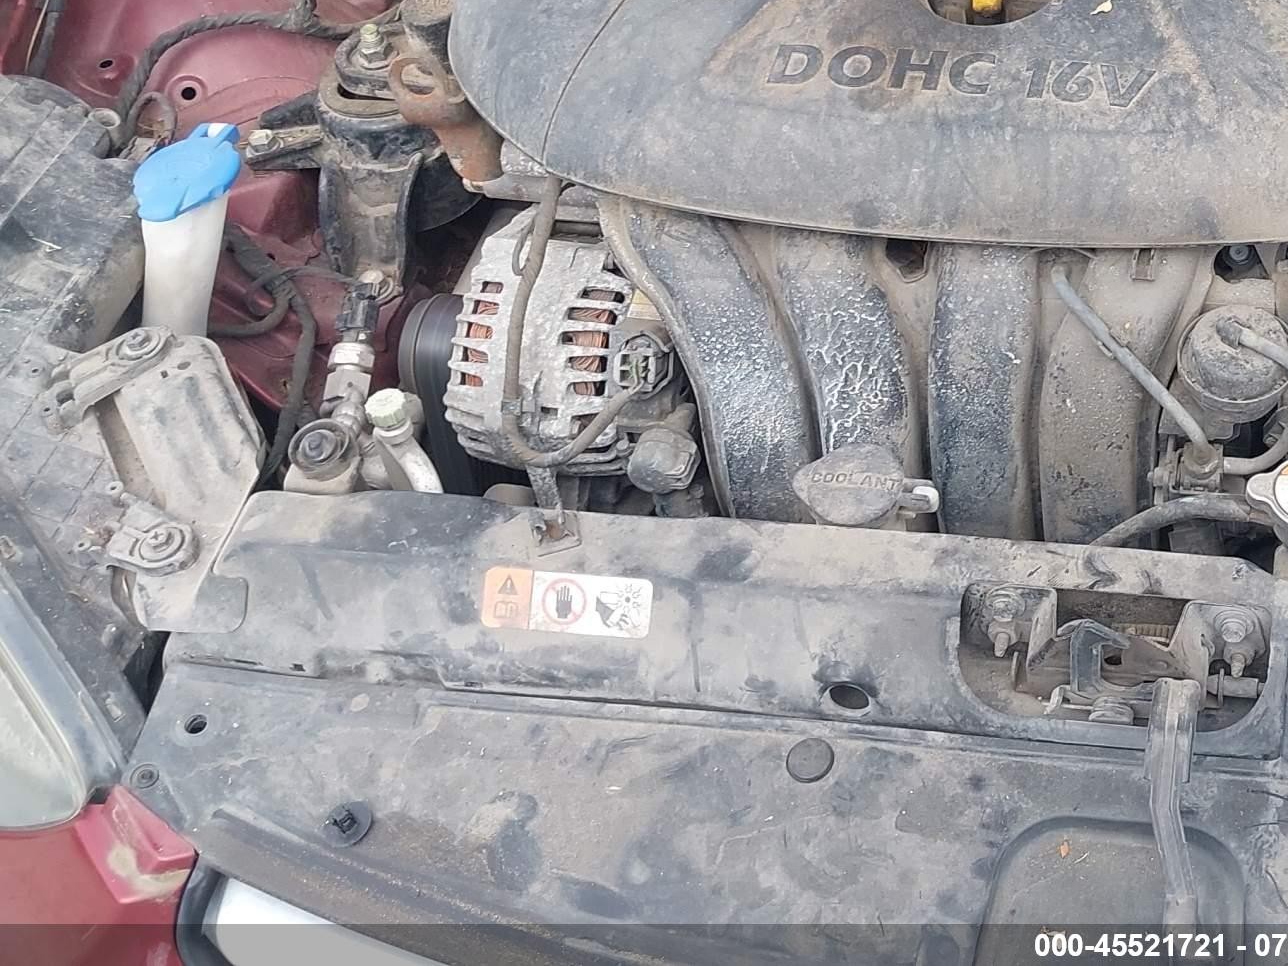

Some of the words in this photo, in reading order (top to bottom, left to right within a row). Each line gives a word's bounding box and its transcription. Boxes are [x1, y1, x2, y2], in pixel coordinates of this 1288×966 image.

[766, 44, 998, 96] DOHC
[1025, 58, 1158, 109] 16V
[811, 472, 901, 491] COOLANT
